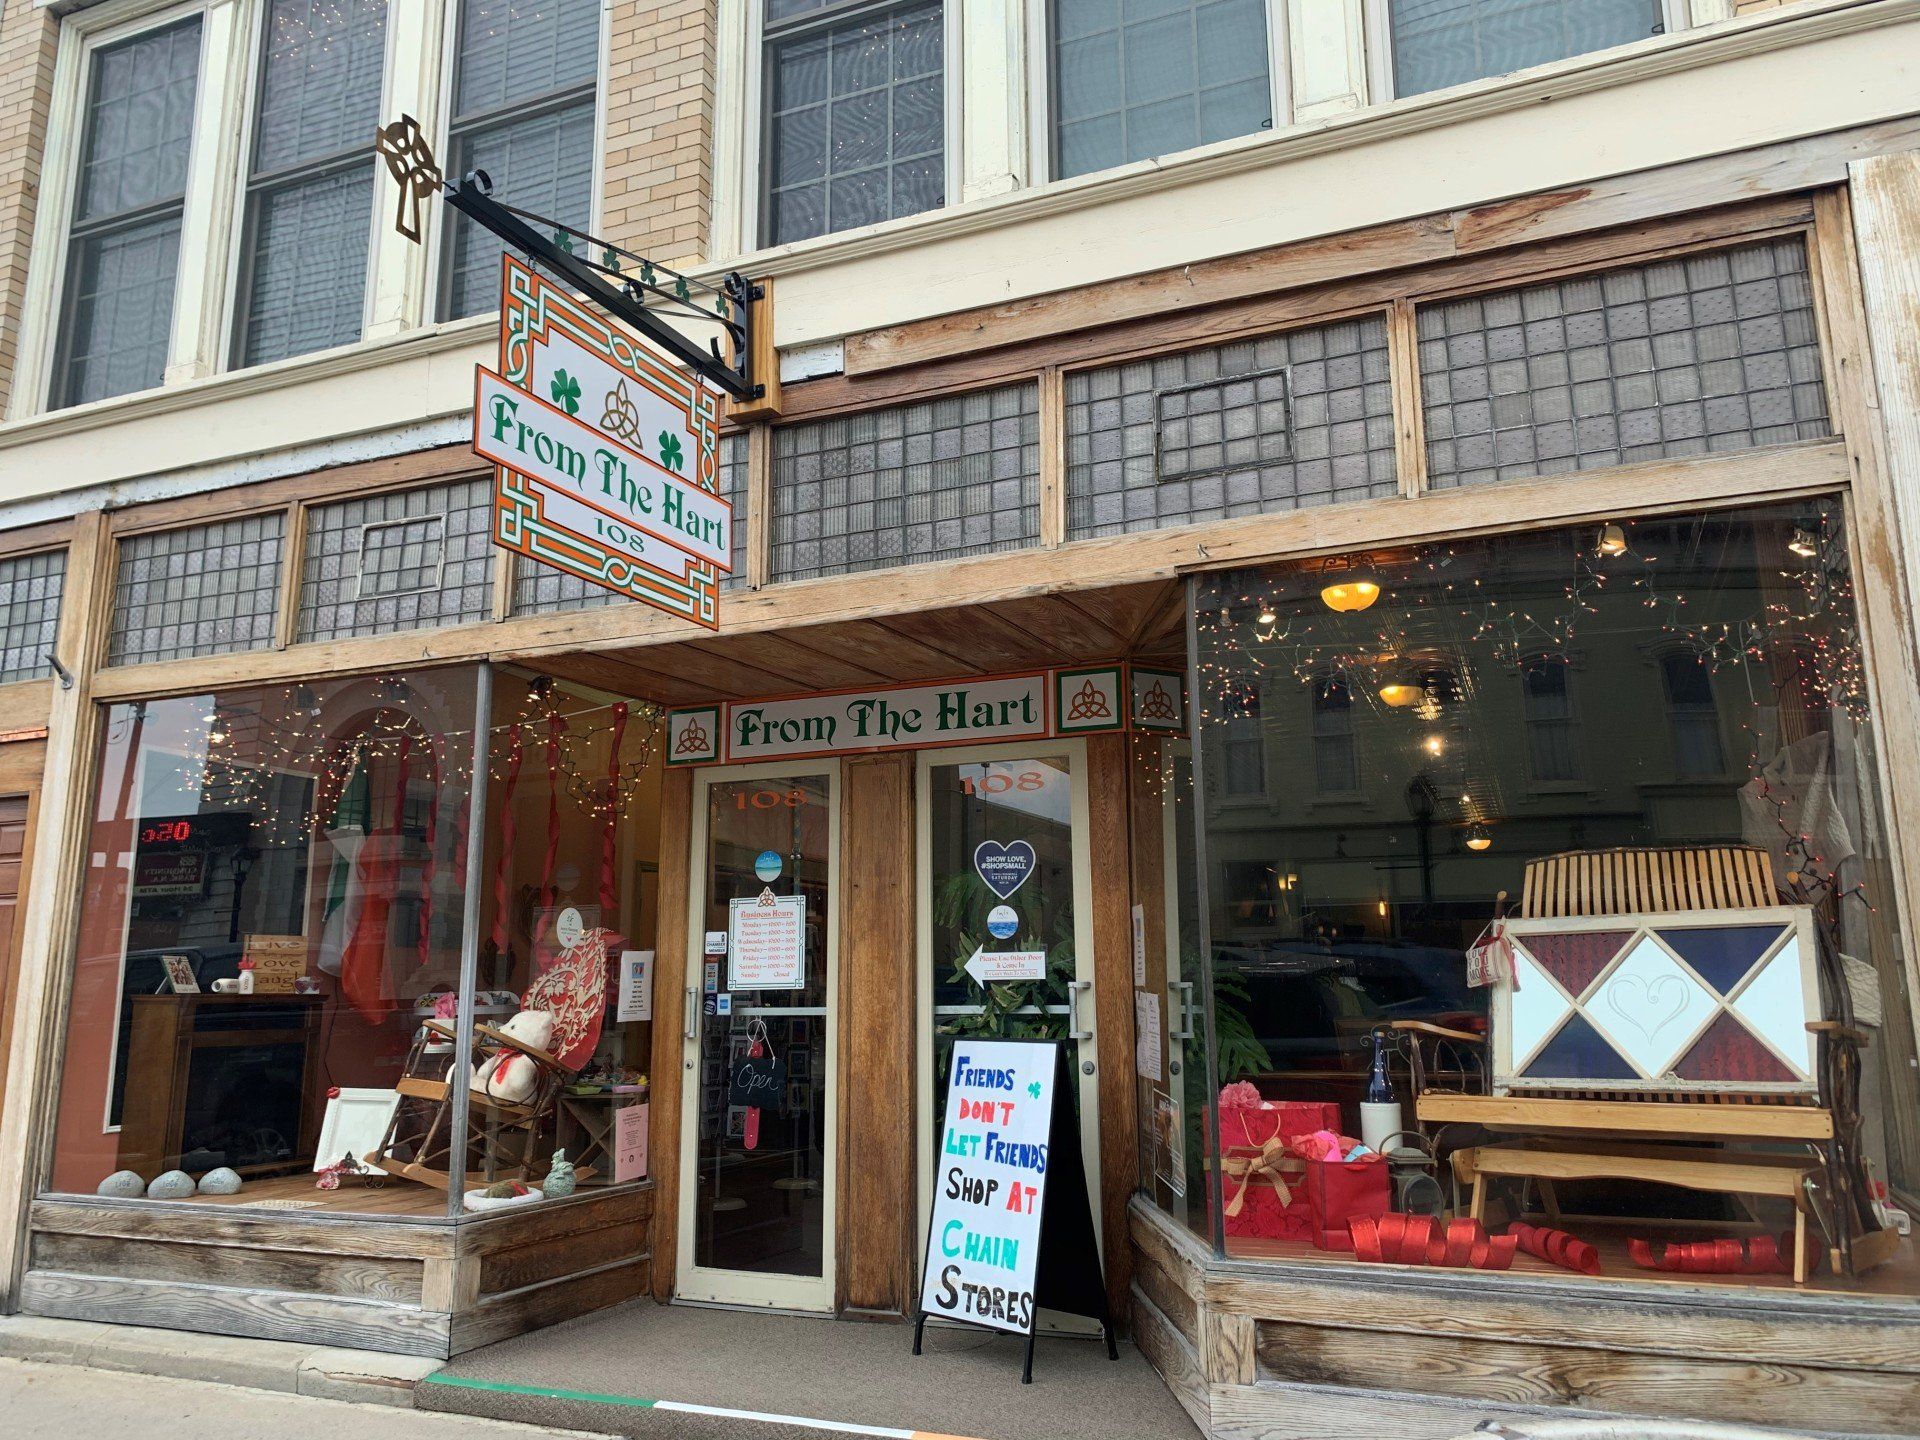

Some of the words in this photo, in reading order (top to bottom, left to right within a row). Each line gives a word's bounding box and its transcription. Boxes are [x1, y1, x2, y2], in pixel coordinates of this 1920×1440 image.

[490, 393, 587, 491] From
[594, 448, 652, 516] The
[661, 480, 726, 551] Hart
[594, 517, 645, 553] 108
[735, 708, 836, 749] From
[846, 698, 922, 742] The
[935, 690, 1039, 732] Hart
[737, 787, 808, 809] 108
[960, 771, 1045, 796] 108
[740, 910, 772, 919] Business
[772, 909, 794, 918] Hours
[742, 921, 762, 929] Monday
[739, 946, 763, 954] Thursday
[742, 955, 759, 963] Friday
[738, 963, 762, 971] Saturday
[737, 1063, 779, 1095] Open
[954, 1055, 1016, 1092] FRIENDS
[958, 1097, 1015, 1127] DON'T
[945, 1128, 982, 1157] LET
[984, 1131, 1048, 1174] FRIENDS
[945, 1166, 999, 1207] SHOP
[1005, 1181, 1038, 1215] AT
[941, 1219, 1019, 1273] CHAIN
[935, 1264, 1034, 1330] STORES
